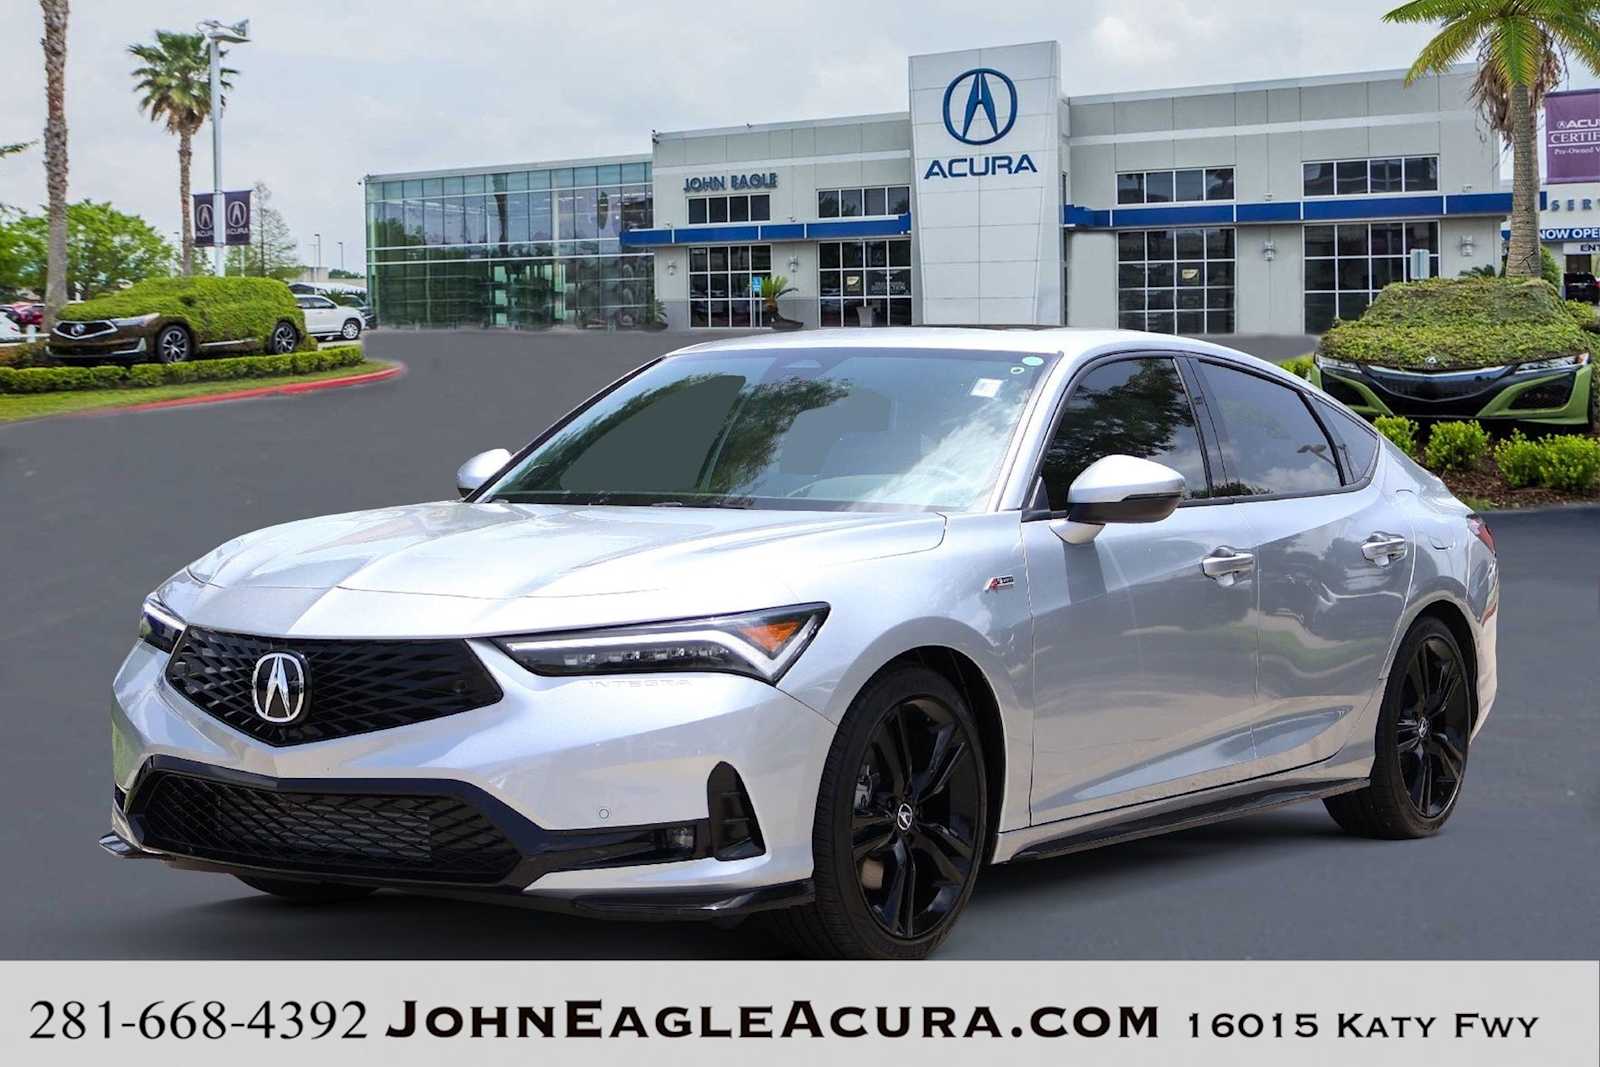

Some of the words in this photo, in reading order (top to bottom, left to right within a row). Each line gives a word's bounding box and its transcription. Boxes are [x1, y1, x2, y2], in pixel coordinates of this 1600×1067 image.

[1566, 119, 1600, 129] ACU
[924, 154, 1037, 179] ACURA
[683, 176, 725, 192] JOHN
[730, 172, 777, 189] EAGLE
[1551, 199, 1600, 212] SER
[1571, 227, 1600, 239] OPE
